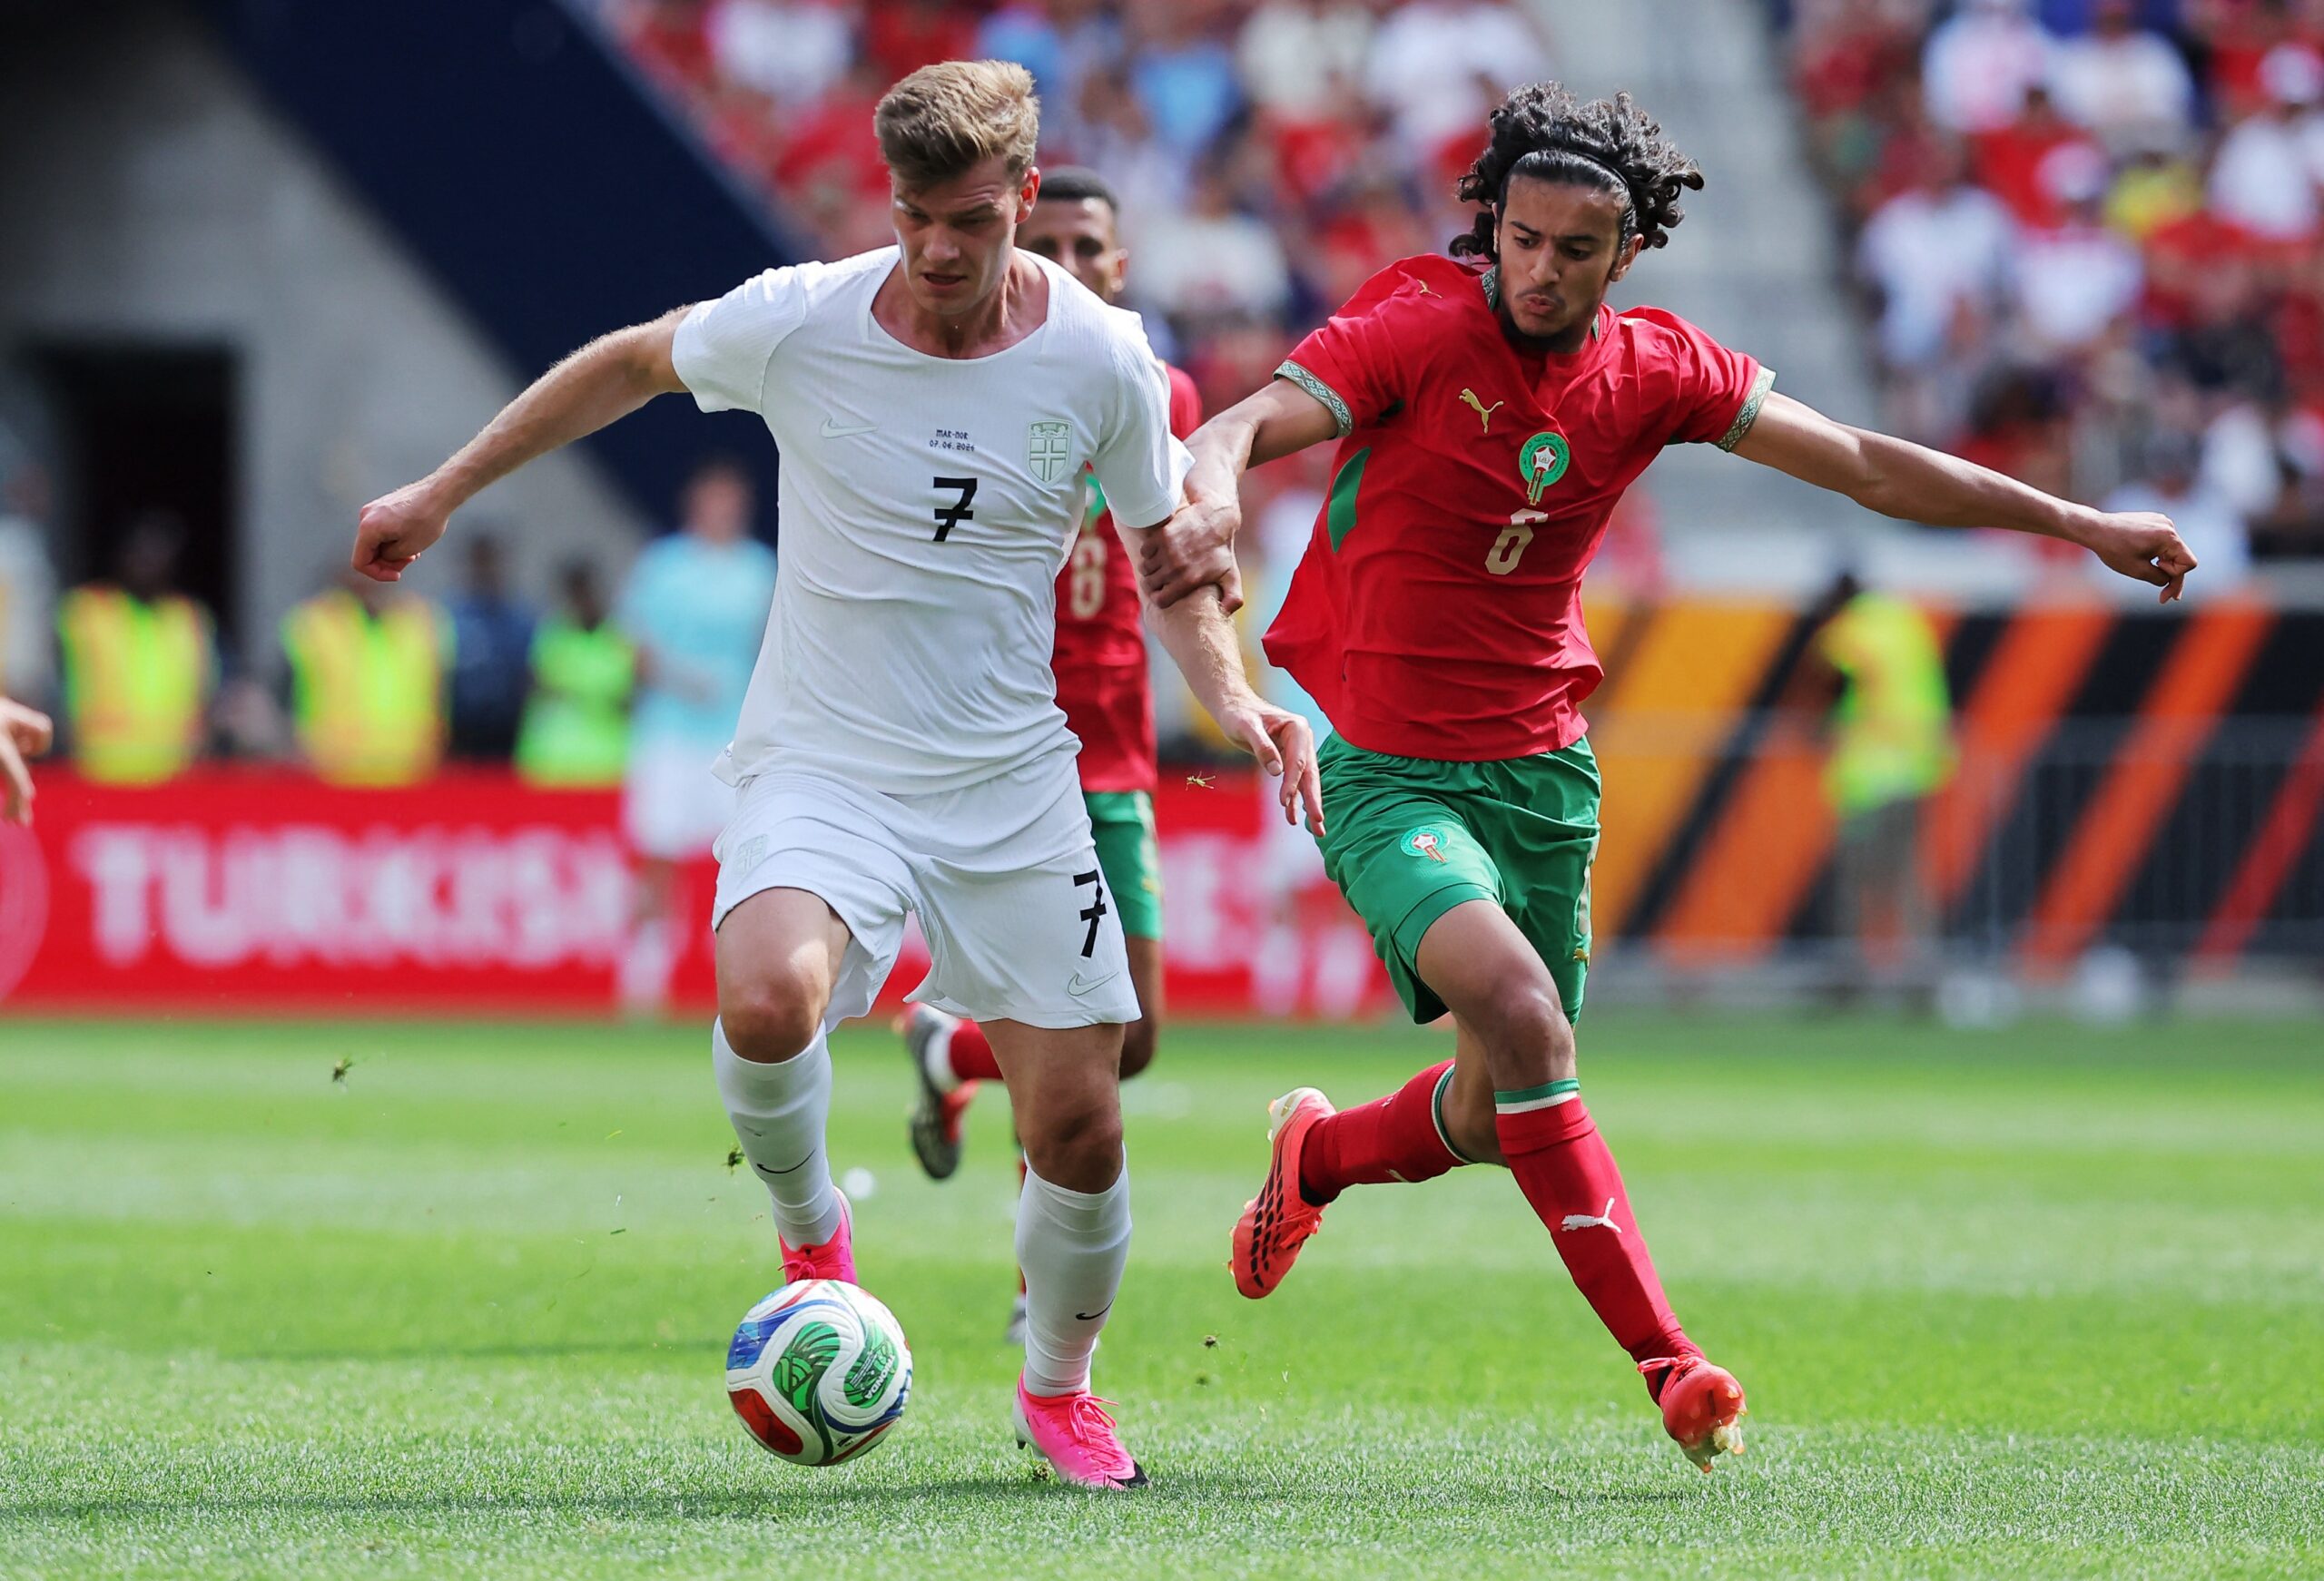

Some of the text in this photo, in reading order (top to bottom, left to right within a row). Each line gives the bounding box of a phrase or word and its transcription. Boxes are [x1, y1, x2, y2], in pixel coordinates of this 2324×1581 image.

[932, 476, 978, 542] 7
[1484, 508, 1549, 575] 6
[1070, 536, 1107, 621] 8
[1072, 869, 1107, 958] 7
[864, 1354, 896, 1400] TRIONDA
